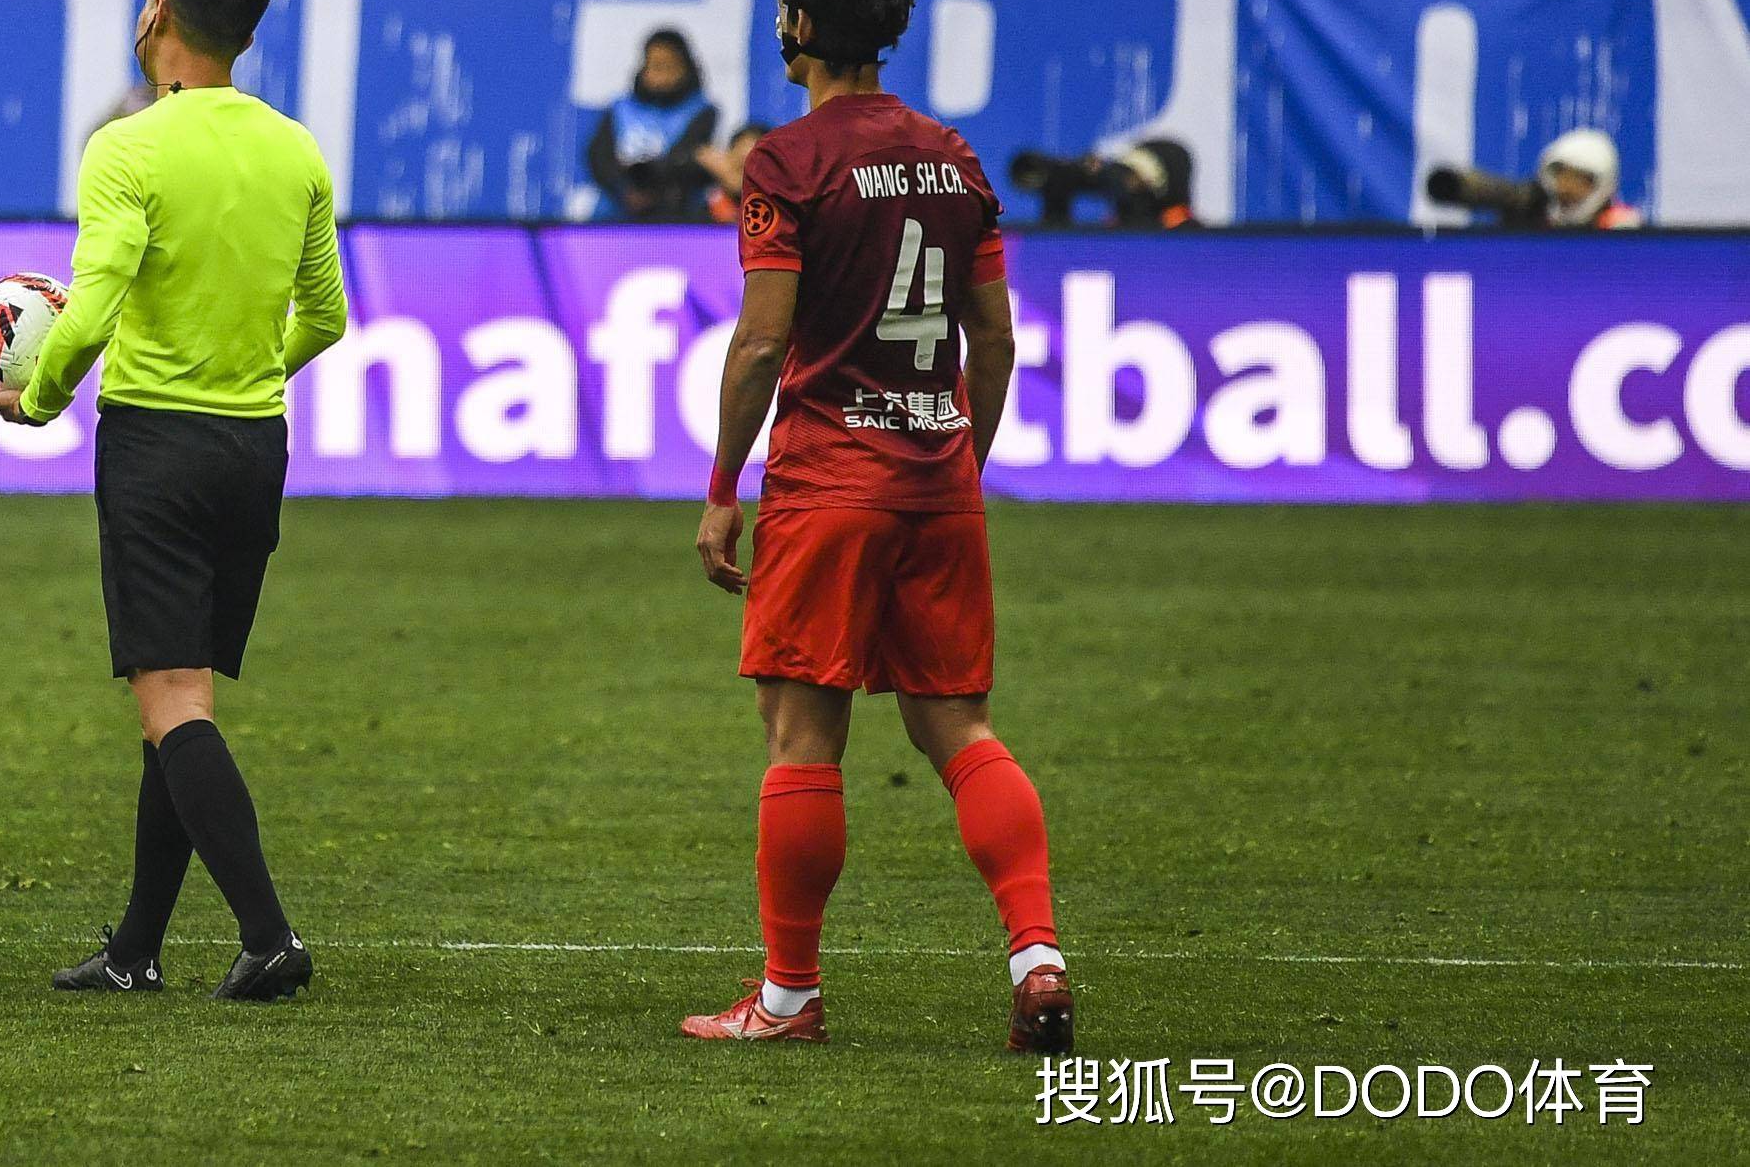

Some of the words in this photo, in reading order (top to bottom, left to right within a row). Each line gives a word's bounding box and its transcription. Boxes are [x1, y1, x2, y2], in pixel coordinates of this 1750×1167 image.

[852, 164, 907, 198] WANG
[916, 162, 967, 195] SH.CH.
[876, 218, 948, 370] 4
[844, 415, 900, 430] SAIC
